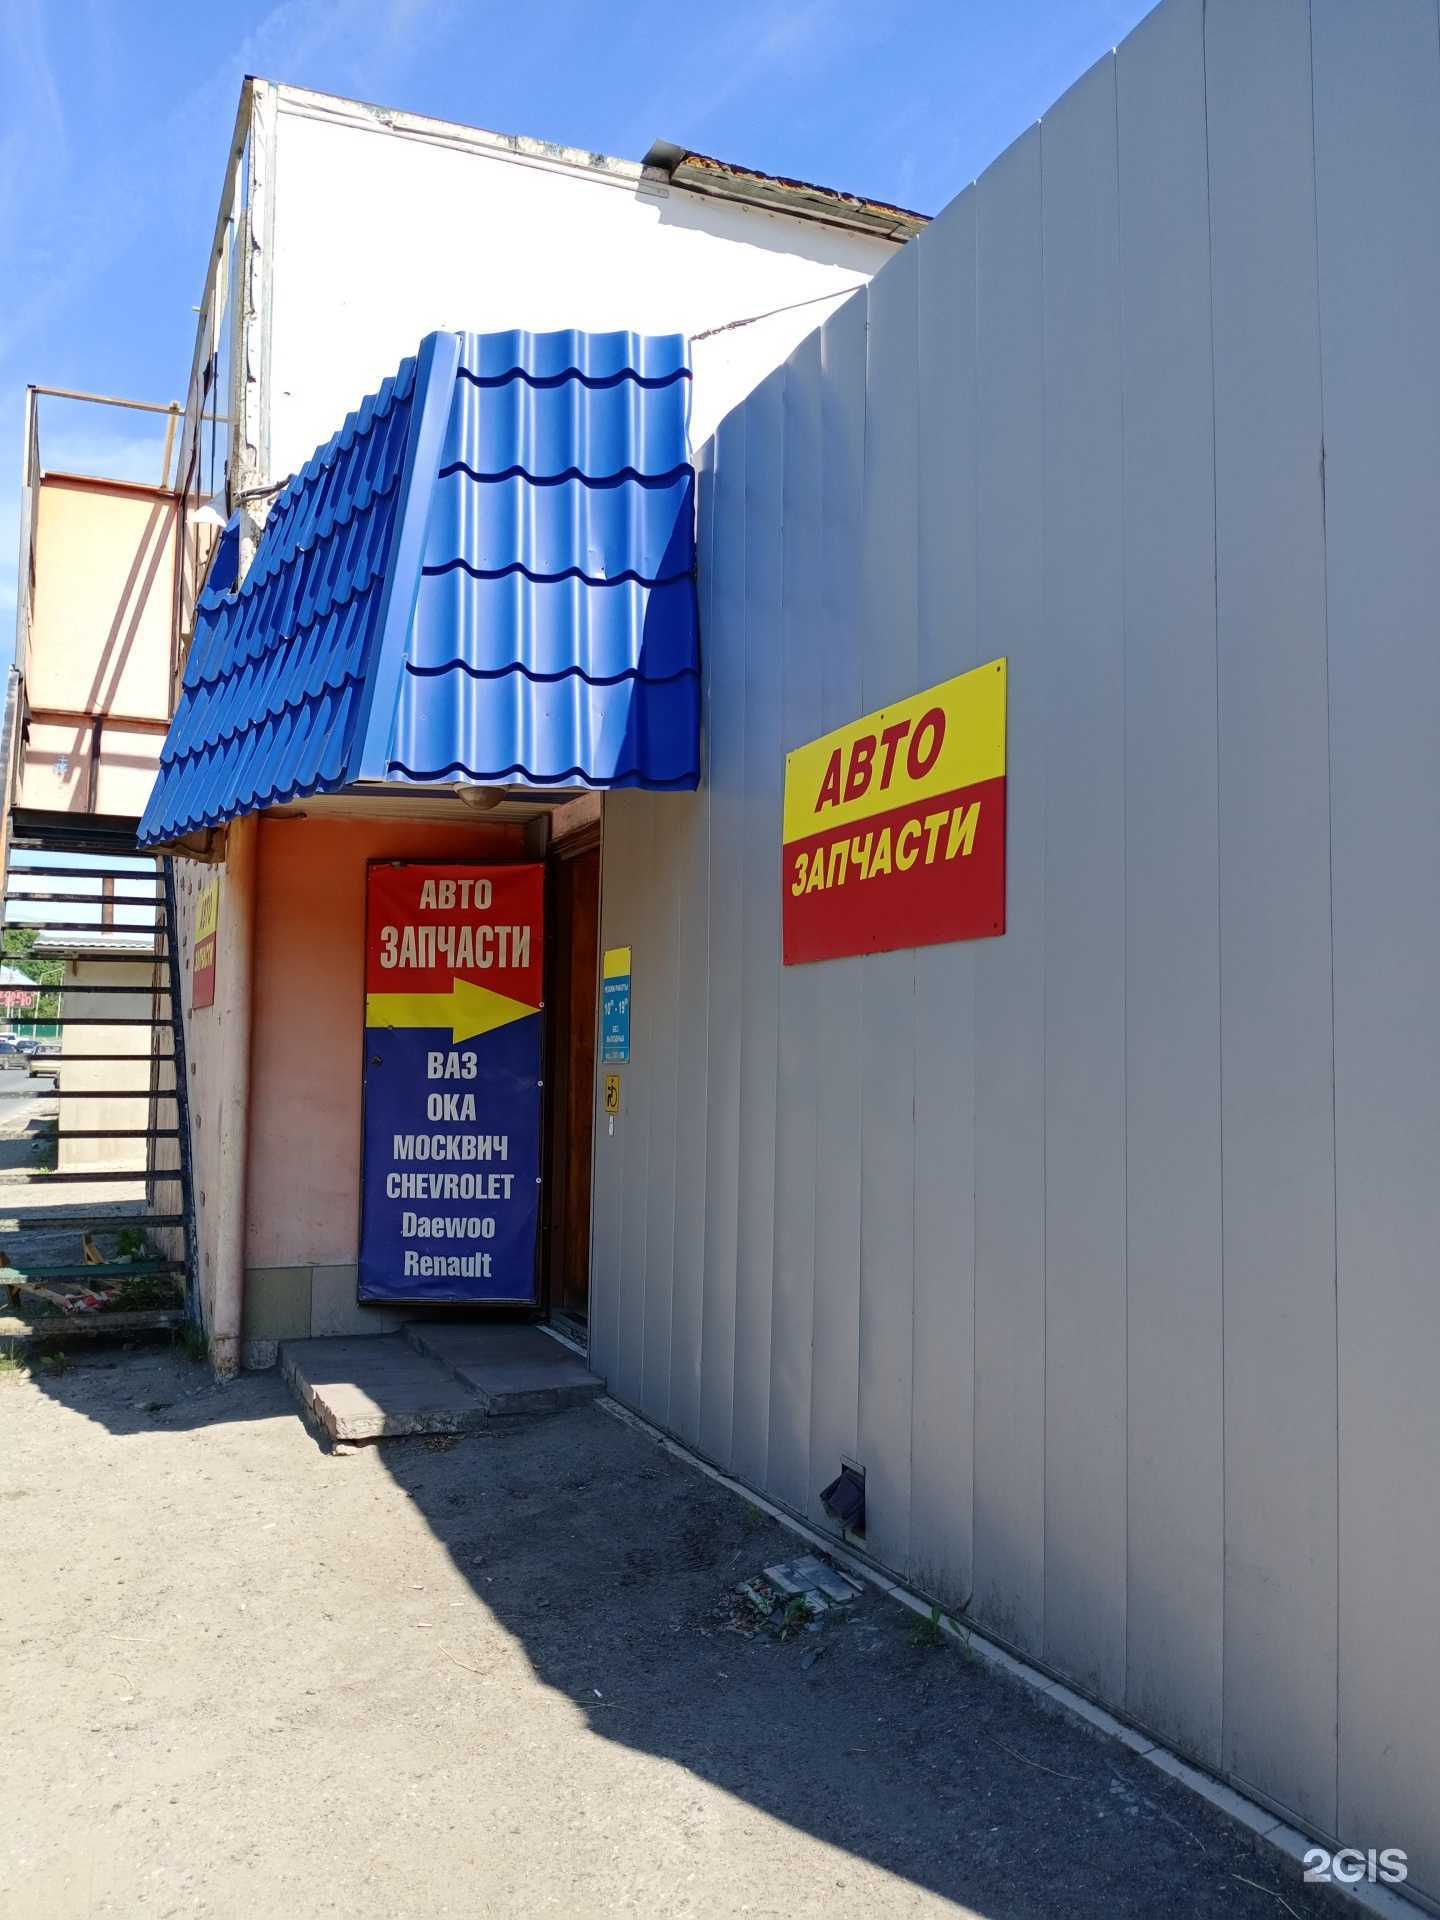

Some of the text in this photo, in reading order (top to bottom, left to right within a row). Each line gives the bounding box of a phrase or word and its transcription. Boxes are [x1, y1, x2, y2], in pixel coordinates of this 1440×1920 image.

[813, 706, 946, 814] АВТО
[791, 800, 982, 898] ЗАПЧАСТИ
[419, 878, 493, 911] АВТО
[379, 925, 532, 970] ЗАПЧАСТИ
[427, 1051, 479, 1080] ВАЗ
[426, 1093, 478, 1122] ОКА
[392, 1134, 509, 1162] МОСКВИЧ
[385, 1172, 516, 1201] CHEVROLET
[401, 1211, 497, 1239] Daewoo
[403, 1250, 493, 1279] Renault
